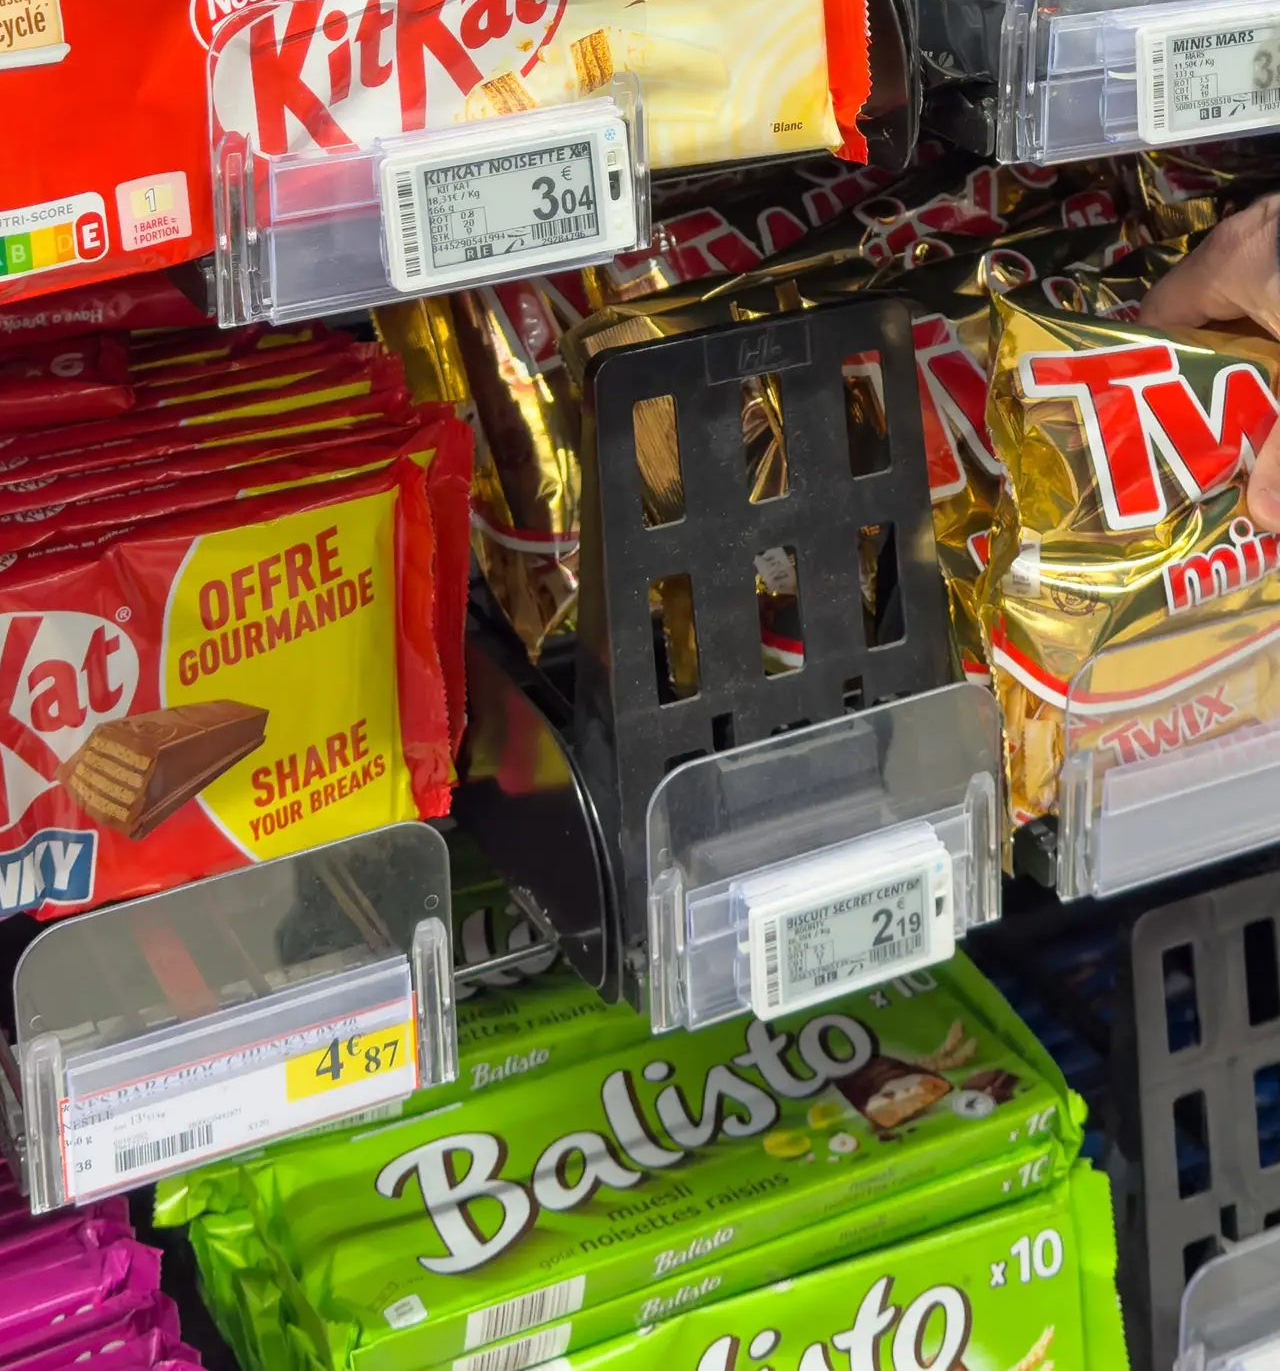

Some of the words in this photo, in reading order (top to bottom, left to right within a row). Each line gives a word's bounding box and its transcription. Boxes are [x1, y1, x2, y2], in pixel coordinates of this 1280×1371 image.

[1172, 35, 1213, 54] MINIS
[1215, 29, 1255, 47] MARS
[1184, 51, 1206, 61] MARS
[1204, 57, 1216, 68] Kg
[423, 162, 487, 187] KITKAT
[488, 147, 566, 175] NOISETTE
[143, 187, 158, 213] 1
[436, 184, 452, 195] KIT
[452, 181, 471, 193] KAT
[468, 189, 480, 200] Kg
[139, 216, 170, 233] BARRE
[428, 205, 447, 216] 166
[430, 214, 450, 226] ROT
[139, 226, 180, 244] PORTION
[432, 232, 451, 243] STK
[199, 524, 343, 632] OFFRE
[178, 567, 375, 687] GOURMANDE
[1098, 684, 1236, 766] TWIX
[251, 717, 370, 808] SHARE
[248, 799, 304, 842] YOUR
[309, 753, 387, 814] BREAKS
[786, 906, 830, 930] BISCUIT
[832, 892, 873, 915] SECRET
[469, 1047, 551, 1092] Balisto
[375, 1010, 874, 1276] Balisto
[75, 1158, 94, 1173] 38
[579, 1205, 702, 1254] noisettes
[705, 1172, 790, 1212] raisins
[607, 1181, 694, 1223] muesli
[652, 1226, 735, 1279] Balisto
[988, 1227, 1064, 1289] x10
[636, 1275, 723, 1325] Balisto
